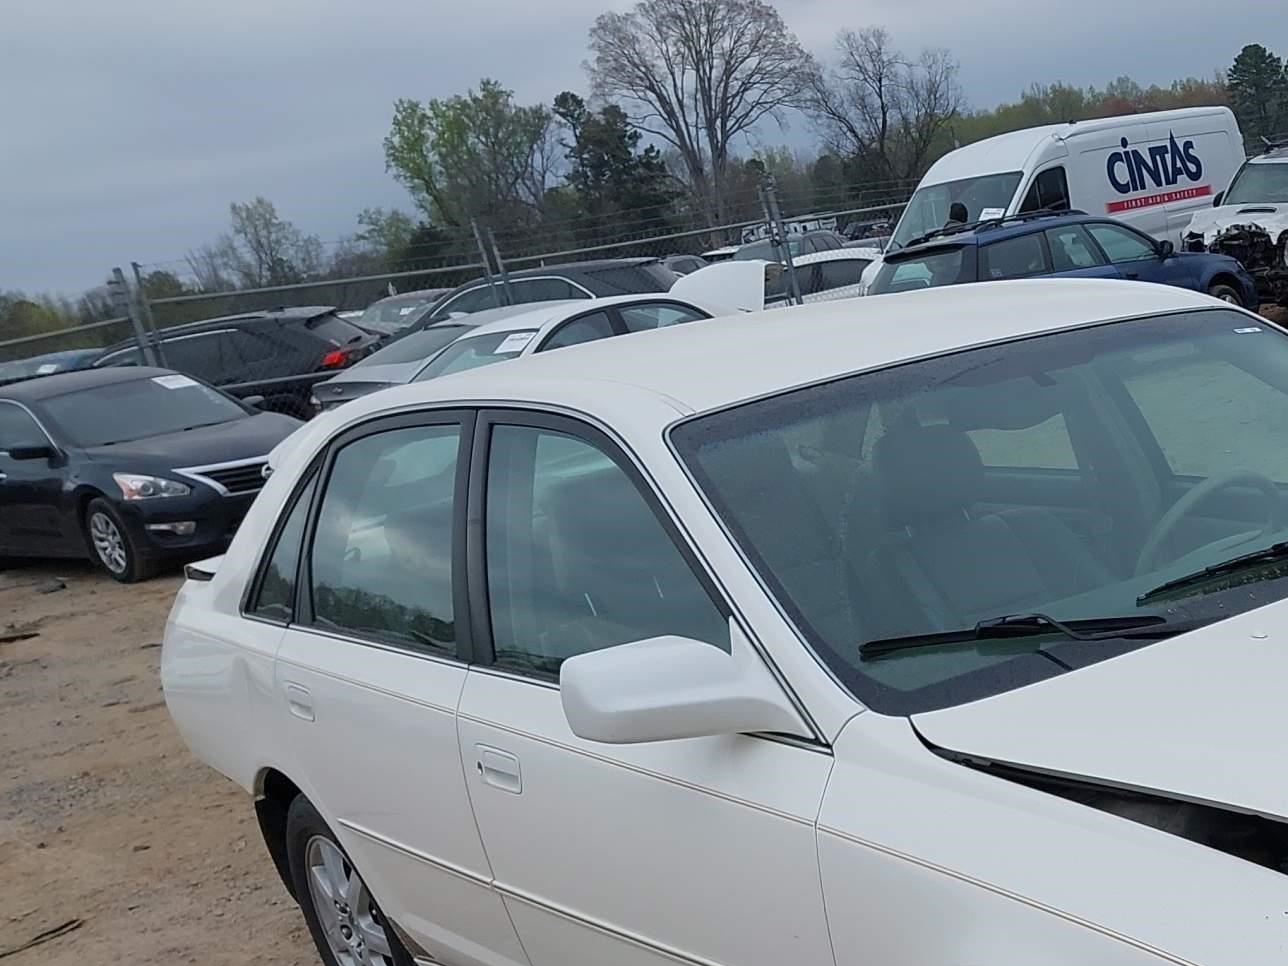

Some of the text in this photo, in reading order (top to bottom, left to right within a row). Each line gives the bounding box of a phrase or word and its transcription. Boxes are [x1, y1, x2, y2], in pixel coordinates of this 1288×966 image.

[1124, 198, 1145, 209] FIRST
[1148, 195, 1161, 204] AID
[1172, 189, 1197, 200] SAFETY
